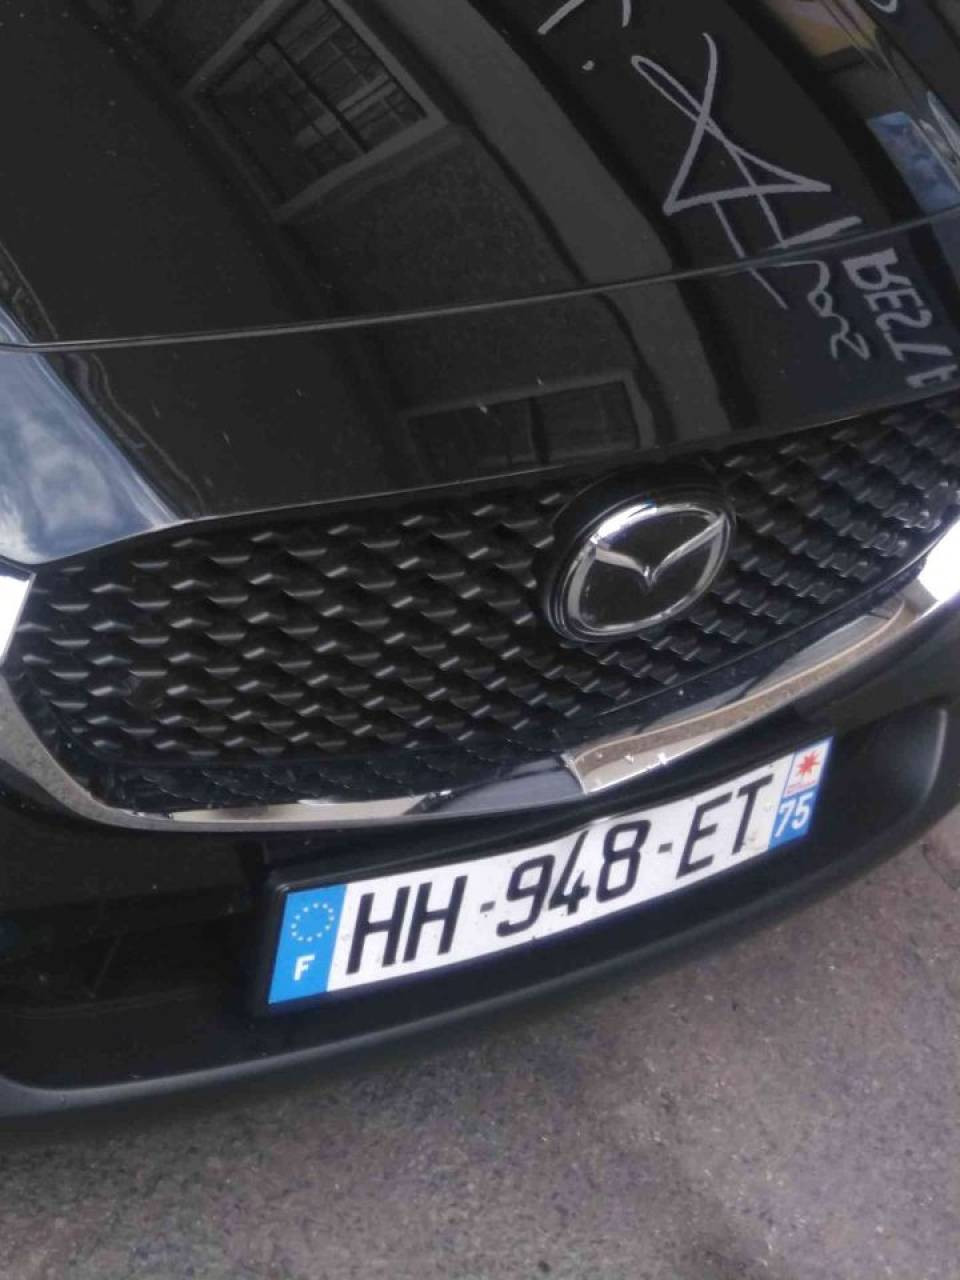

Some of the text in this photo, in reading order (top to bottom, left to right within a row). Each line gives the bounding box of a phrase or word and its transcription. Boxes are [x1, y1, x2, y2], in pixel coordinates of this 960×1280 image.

[345, 773, 815, 975] HH-948-ET 75
[294, 955, 316, 982] F
